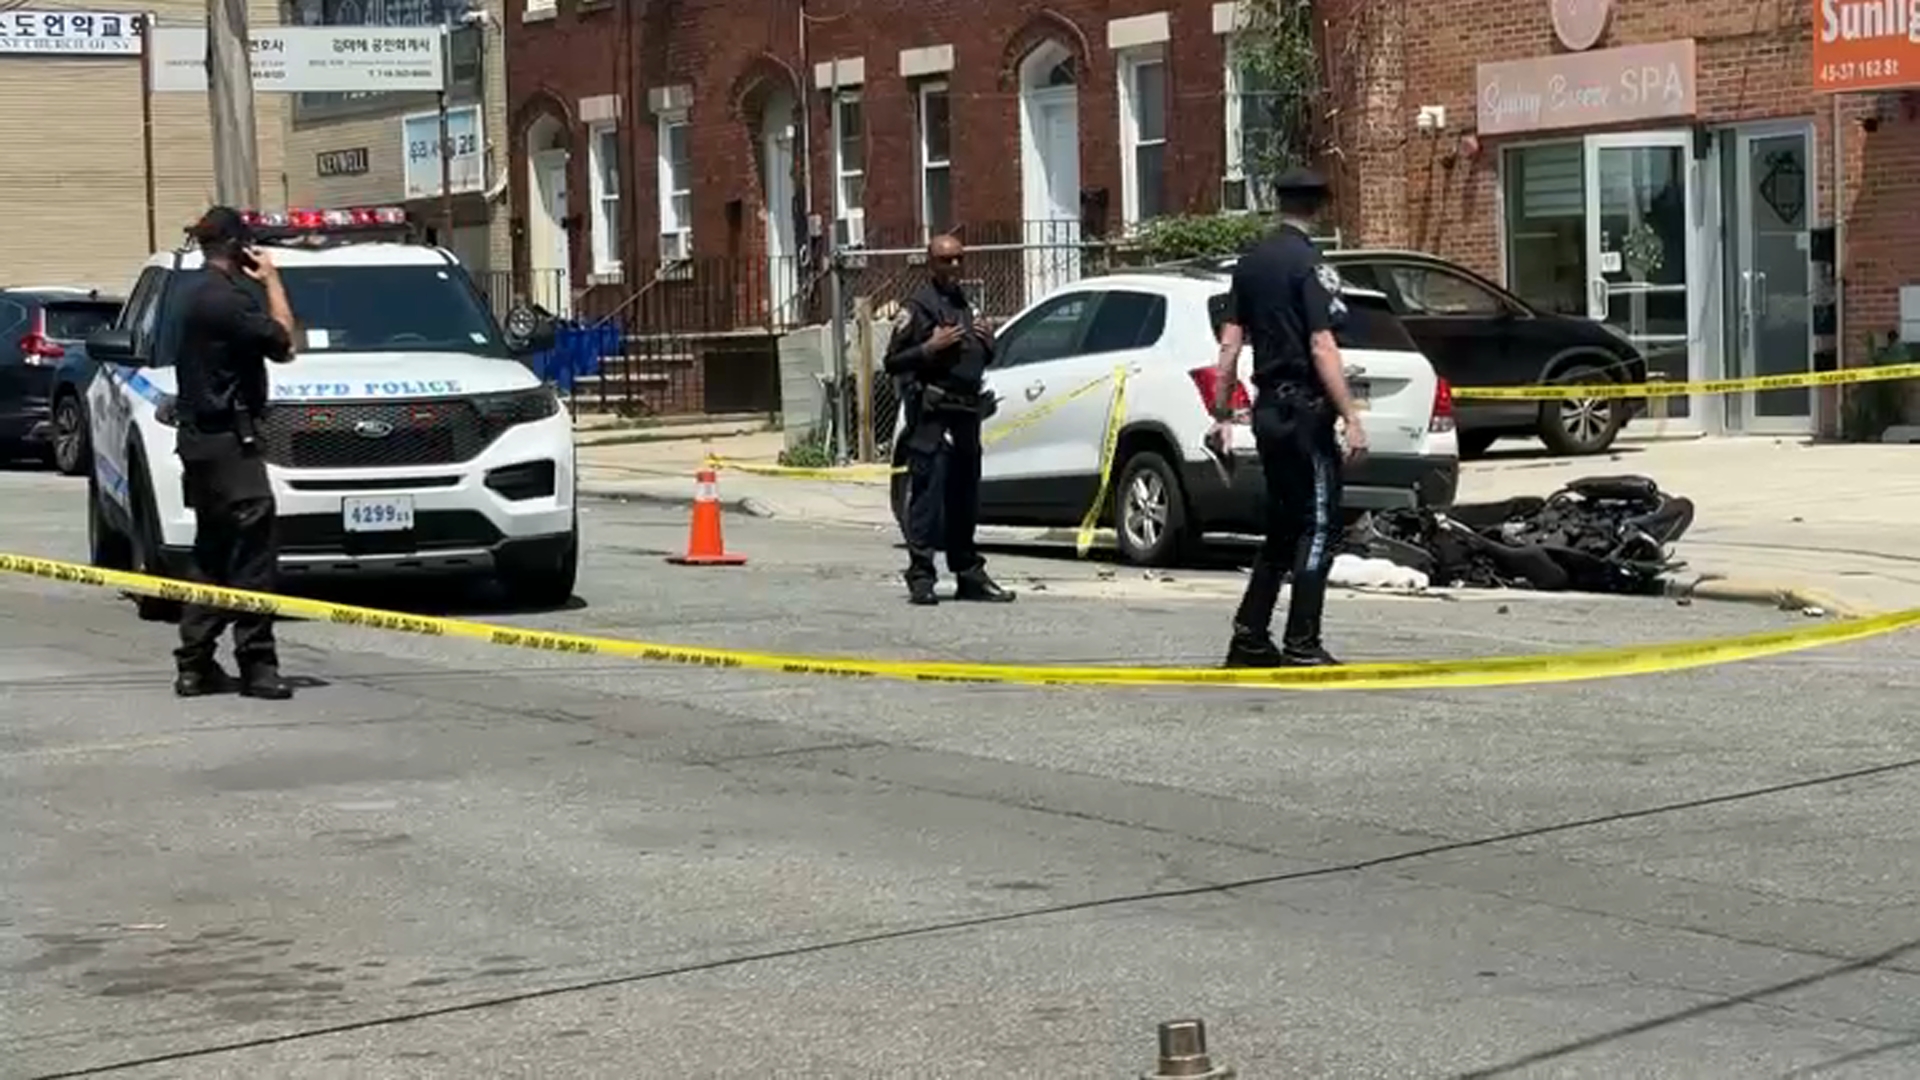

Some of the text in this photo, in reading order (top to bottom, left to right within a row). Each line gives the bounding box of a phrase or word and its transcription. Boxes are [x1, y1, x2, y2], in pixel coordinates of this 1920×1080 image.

[1820, 62, 1855, 82] 45-37
[1884, 58, 1899, 76] St
[1620, 60, 1684, 104] SPA
[274, 380, 462, 397] NYPD POLICE
[351, 504, 396, 523] 4299
